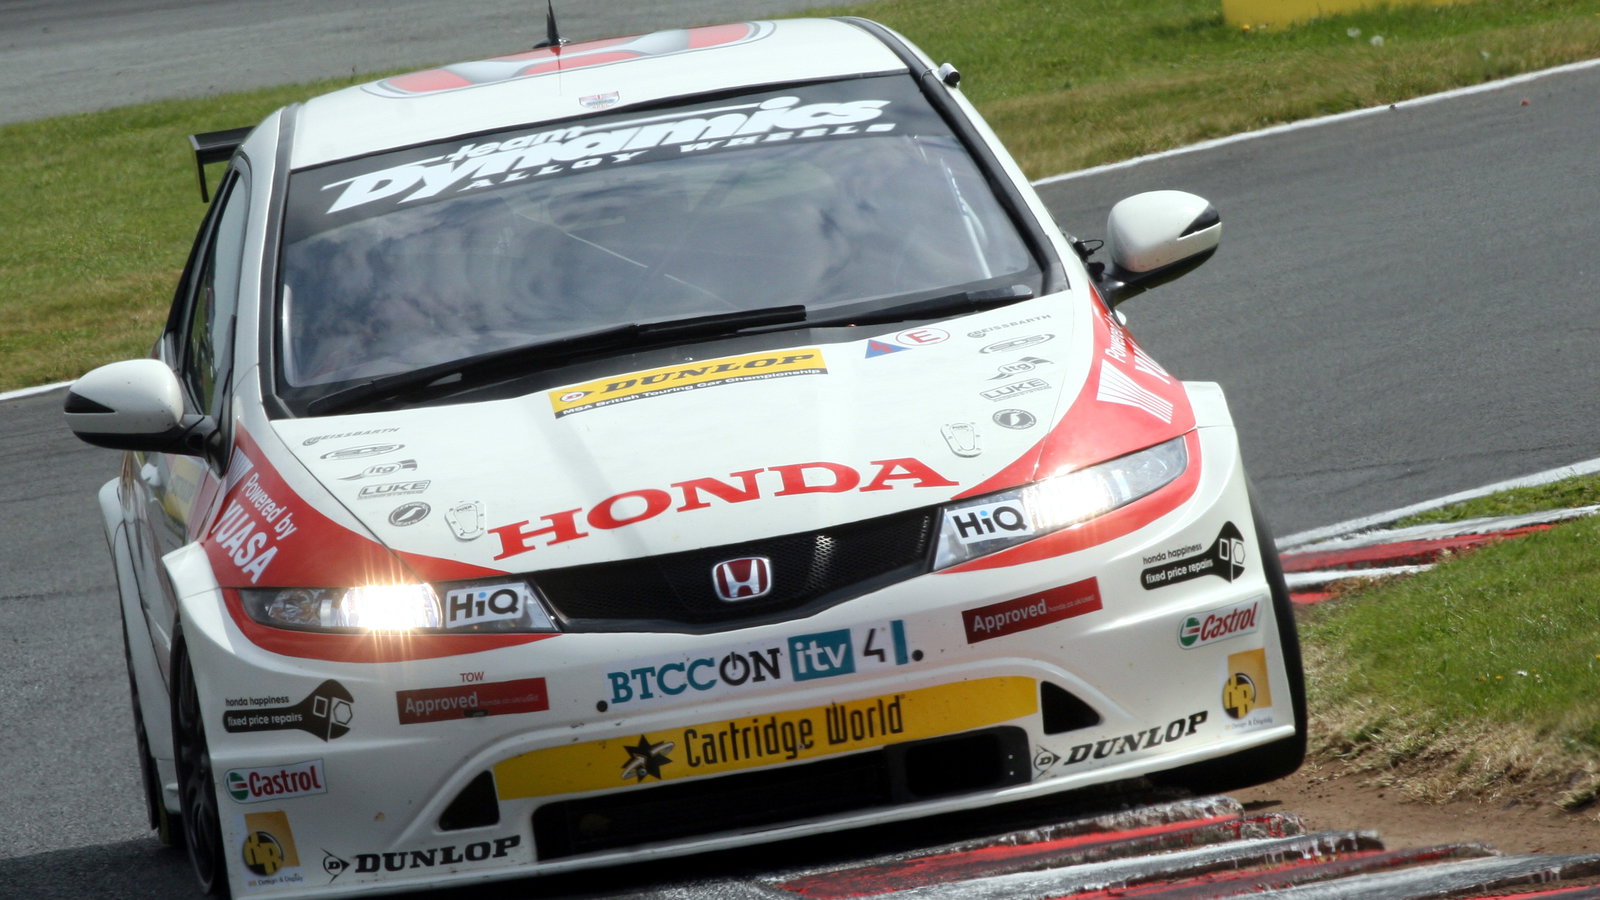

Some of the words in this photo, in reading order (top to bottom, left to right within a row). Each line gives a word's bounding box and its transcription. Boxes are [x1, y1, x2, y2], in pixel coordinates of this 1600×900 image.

[320, 96, 891, 215] Dynamics
[446, 125, 586, 162] team
[457, 150, 650, 192] ALLOY
[680, 123, 896, 153] WHEELS
[906, 330, 941, 344] E
[600, 353, 815, 394] DUNLOP
[984, 379, 1046, 399] LUKE
[562, 404, 593, 415] MSA
[595, 394, 640, 407] British
[642, 384, 694, 398] Touring
[696, 380, 722, 388] Car
[725, 369, 820, 383] Championship
[241, 472, 288, 524] Powered
[274, 512, 299, 541] by
[361, 482, 427, 496] LUKE
[487, 457, 960, 561] HONDA
[951, 505, 1028, 539] HiQ
[210, 498, 279, 585] YUASA
[1142, 552, 1167, 565] honda
[1167, 543, 1202, 559] happiness
[1145, 569, 1166, 584] fixed
[1167, 566, 1187, 580] price
[1188, 558, 1213, 573] repairs
[449, 588, 519, 622] HiQ
[973, 599, 1048, 634] Approved
[1200, 601, 1259, 642] Castrol
[795, 639, 848, 674] itv
[863, 628, 886, 663] 4
[460, 671, 485, 682] TOW
[225, 696, 248, 706] honda
[249, 695, 289, 706] happiness
[405, 691, 478, 716] Approved
[227, 715, 247, 726] fixed
[248, 714, 270, 726] price
[271, 713, 303, 725] repairs
[684, 717, 815, 768] Cartridge
[825, 695, 905, 745] World
[1064, 710, 1208, 766] DUNLOP
[250, 766, 322, 797] Castrol
[355, 835, 521, 873] DUNLOP
